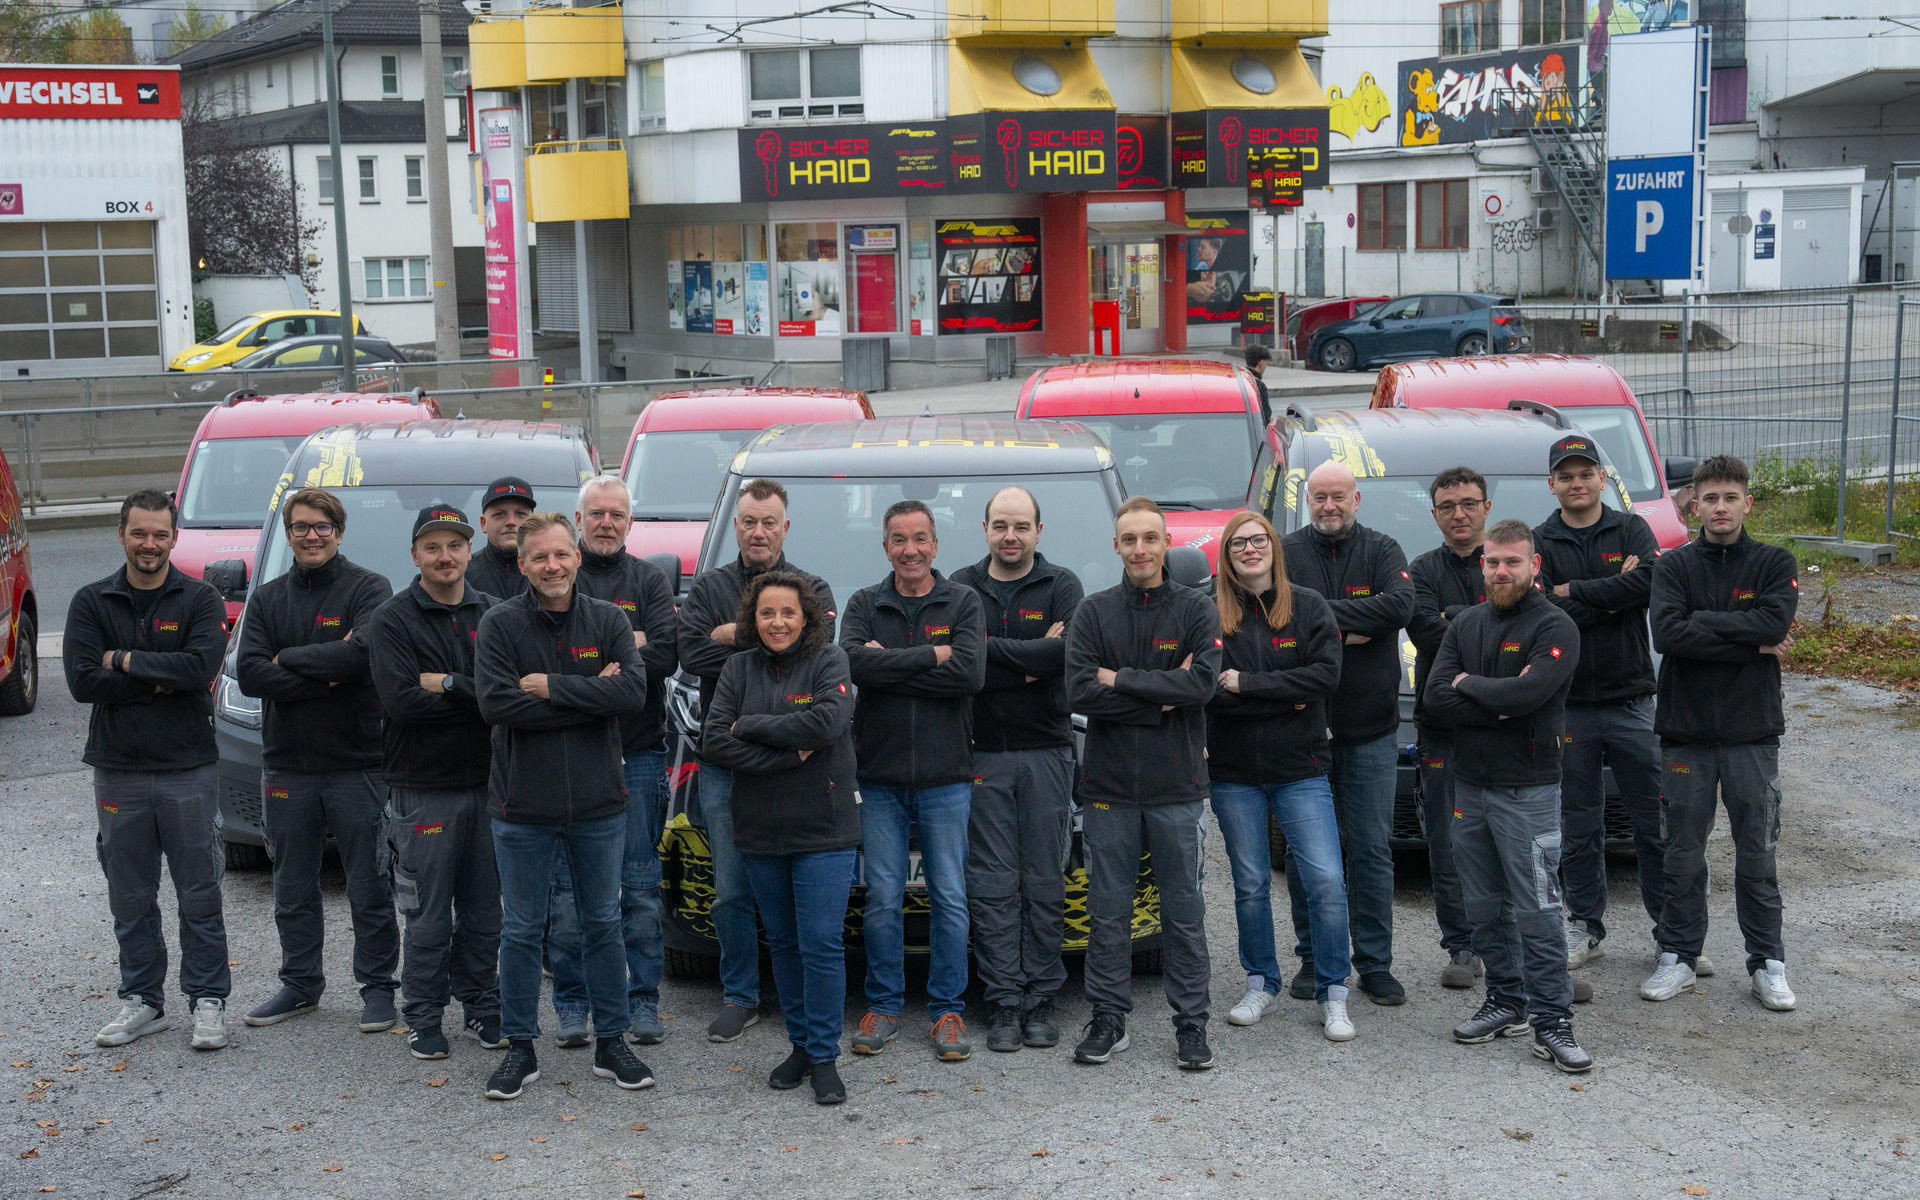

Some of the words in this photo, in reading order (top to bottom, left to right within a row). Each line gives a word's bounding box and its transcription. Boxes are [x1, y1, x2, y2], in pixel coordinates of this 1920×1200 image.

[1028, 129, 1104, 147] SICHER
[1248, 128, 1319, 144] SICHER
[789, 138, 869, 157] SICHER
[1029, 150, 1105, 176] HAID
[1182, 160, 1206, 173] HAID
[789, 158, 871, 185] HAID
[959, 164, 981, 179] HAID
[1274, 177, 1302, 187] HAID
[1615, 170, 1685, 191] ZUFAHRT
[106, 201, 140, 213] BOX
[144, 201, 153, 213] 4
[1635, 200, 1664, 253] P
[1126, 254, 1159, 263] SICHER
[1126, 263, 1159, 274] HAID
[1247, 312, 1264, 320] HAID
[579, 651, 599, 659] HAID
[794, 696, 813, 704] HAID
[423, 826, 443, 835] HAID
